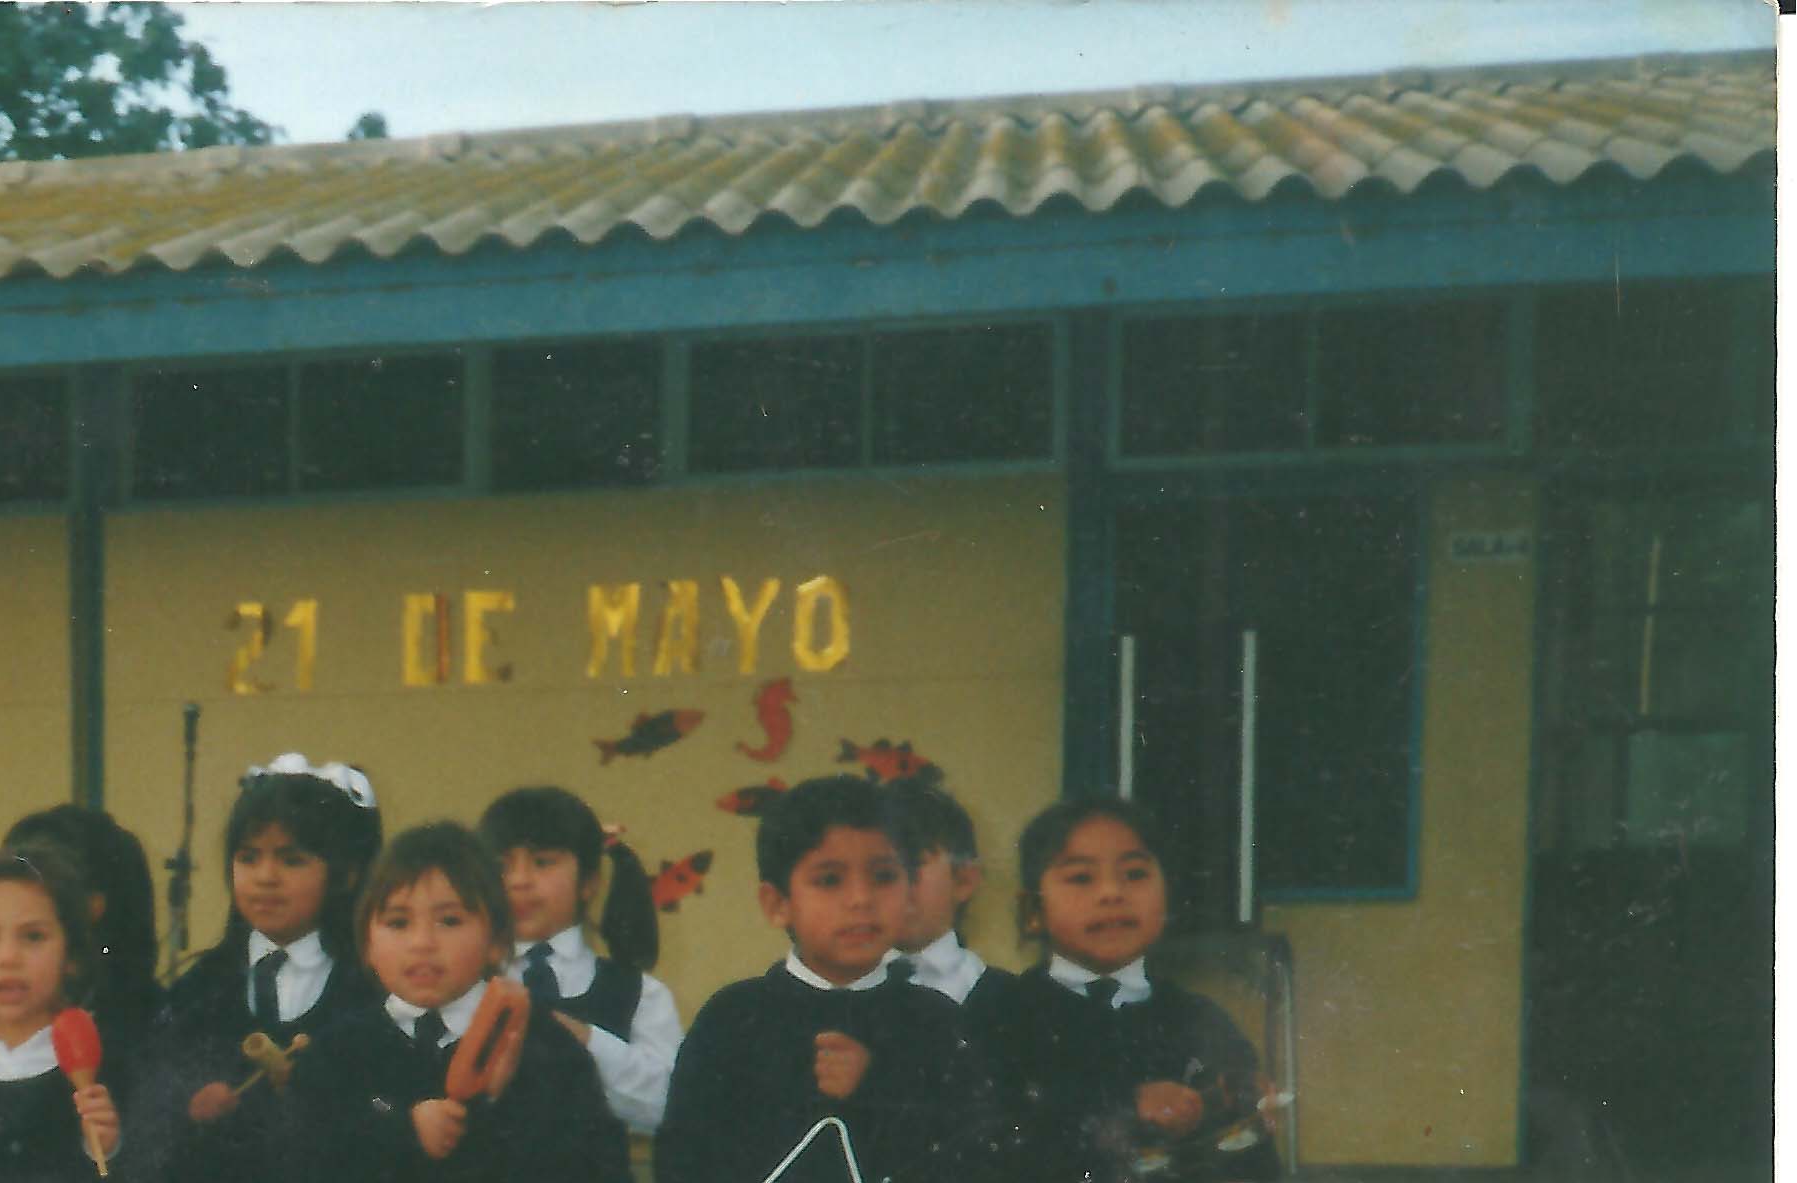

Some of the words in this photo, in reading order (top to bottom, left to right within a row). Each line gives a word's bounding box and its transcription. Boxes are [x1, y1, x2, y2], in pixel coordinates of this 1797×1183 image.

[225, 598, 319, 695] 21
[403, 591, 514, 685] DE
[588, 575, 852, 677] MAYO
